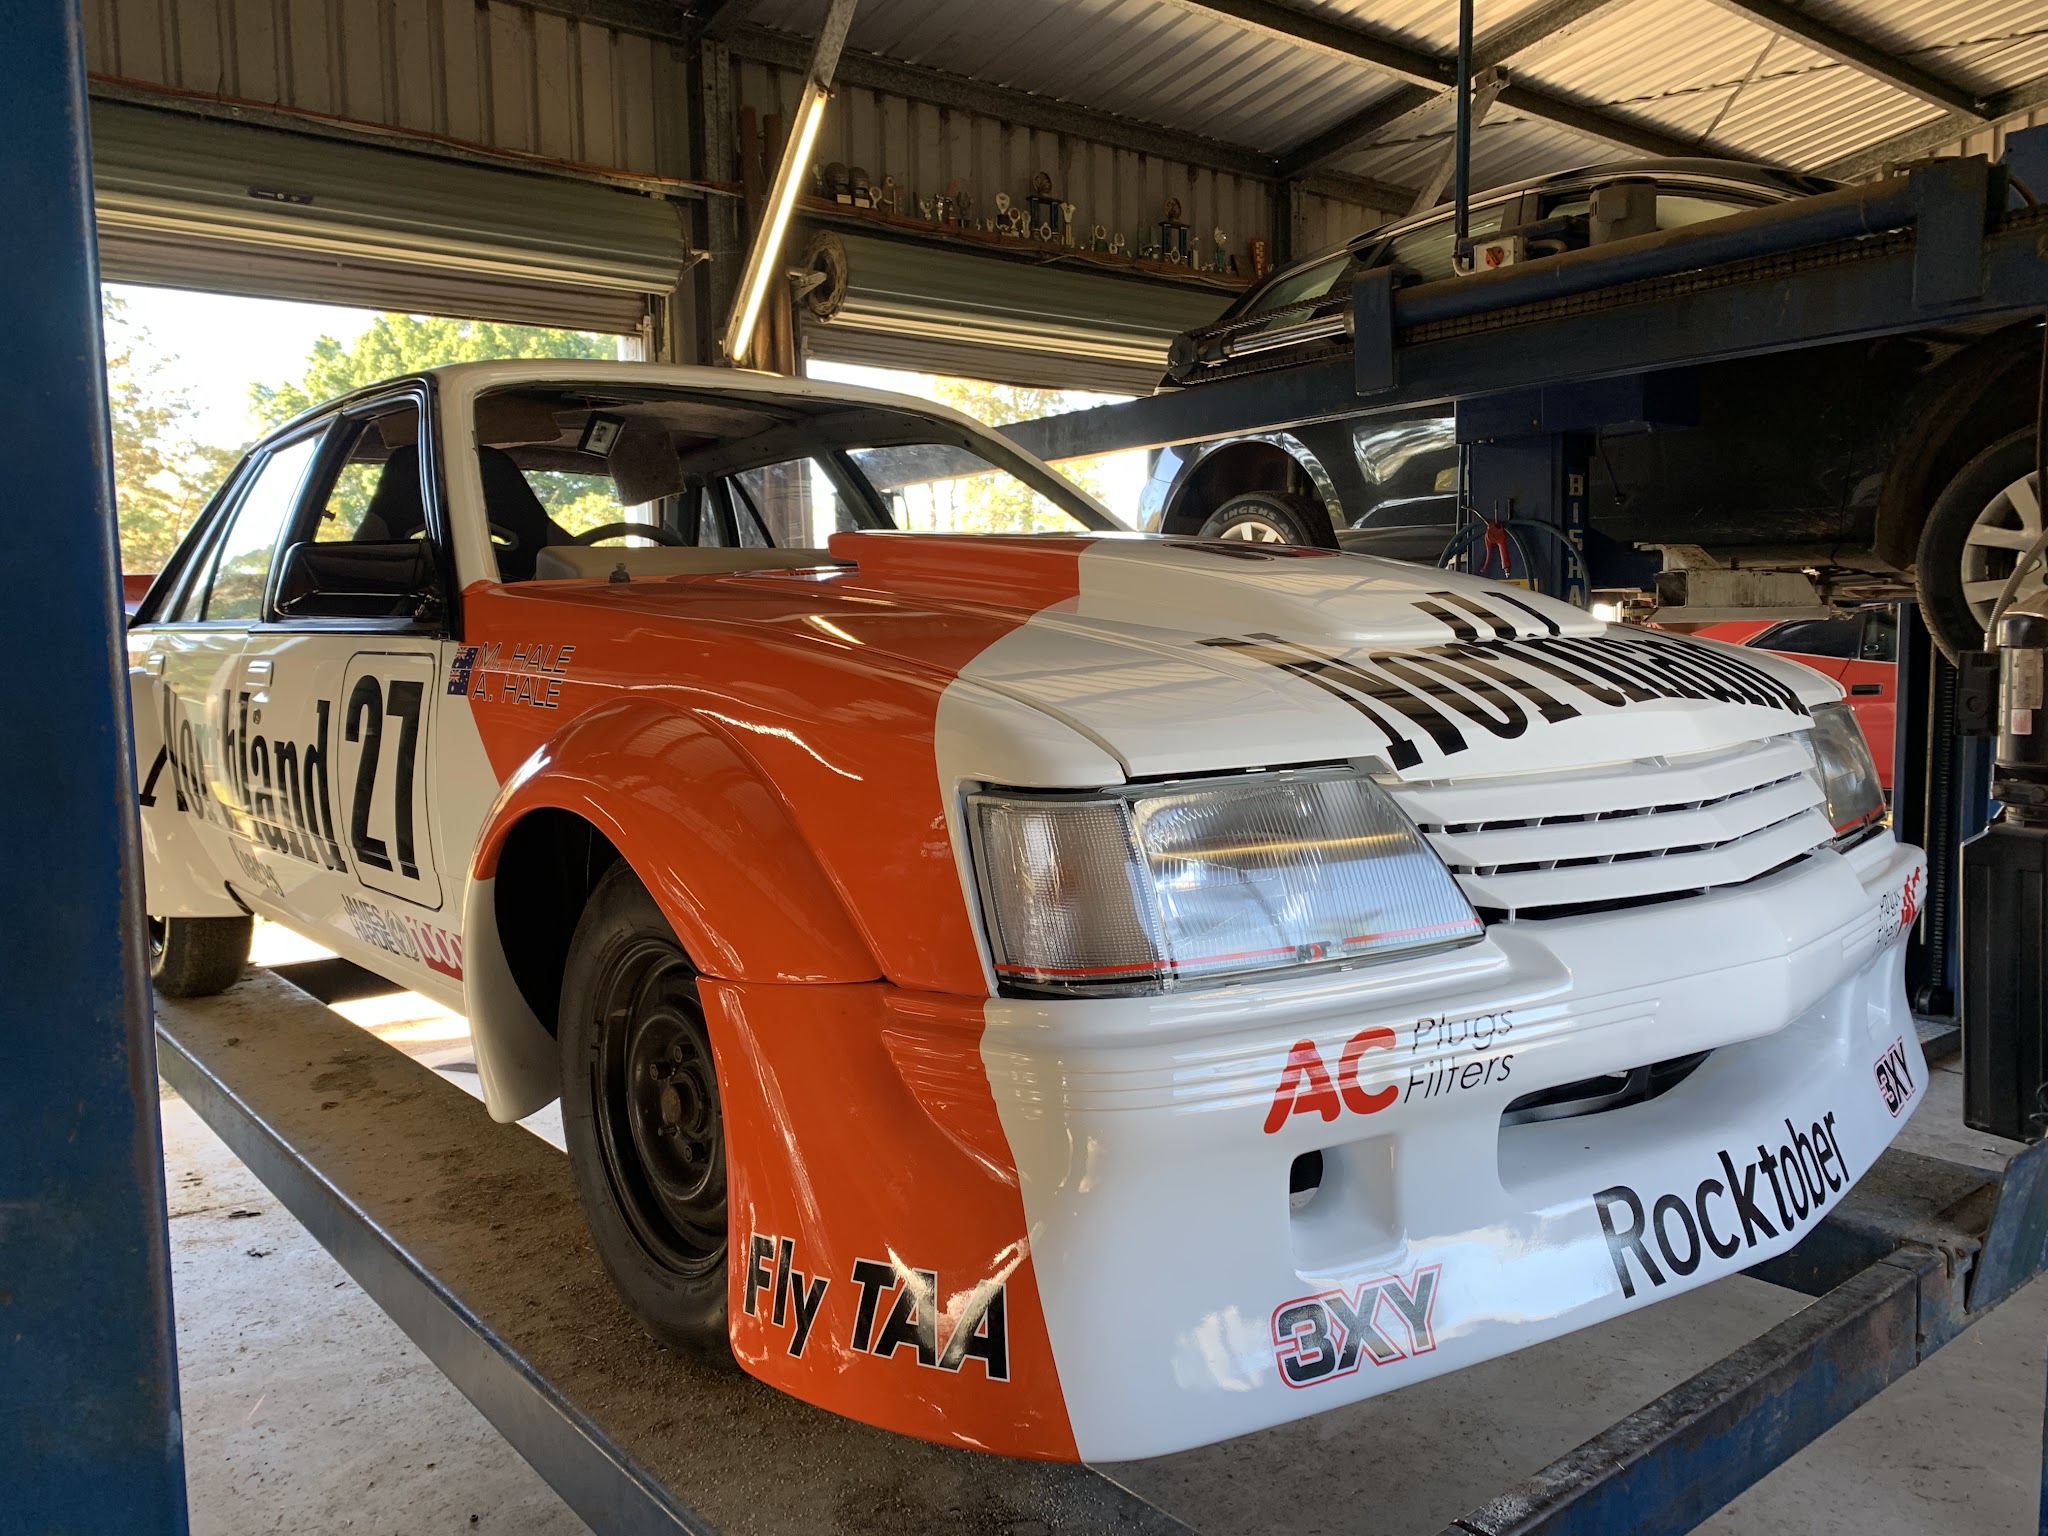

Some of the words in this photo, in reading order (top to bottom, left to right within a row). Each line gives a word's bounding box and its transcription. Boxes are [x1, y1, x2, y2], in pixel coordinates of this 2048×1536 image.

[1223, 506, 1277, 521] INGENS
[475, 641, 502, 670] M.
[508, 643, 576, 674] HALE
[471, 672, 493, 703] A.
[501, 674, 563, 710] HALE
[345, 675, 424, 881] 27
[341, 893, 386, 929] JAMES
[349, 914, 401, 956] HARDIE
[1412, 1010, 1513, 1054] Plugs
[1264, 1026, 1399, 1133] AC
[1404, 1055, 1514, 1103] Filters
[1874, 1036, 1916, 1118] 3XY
[1592, 1111, 1850, 1299] Rocktober
[742, 1231, 831, 1359] Fly
[851, 1257, 1011, 1383] TAA
[1272, 1265, 1441, 1389] 3XY
